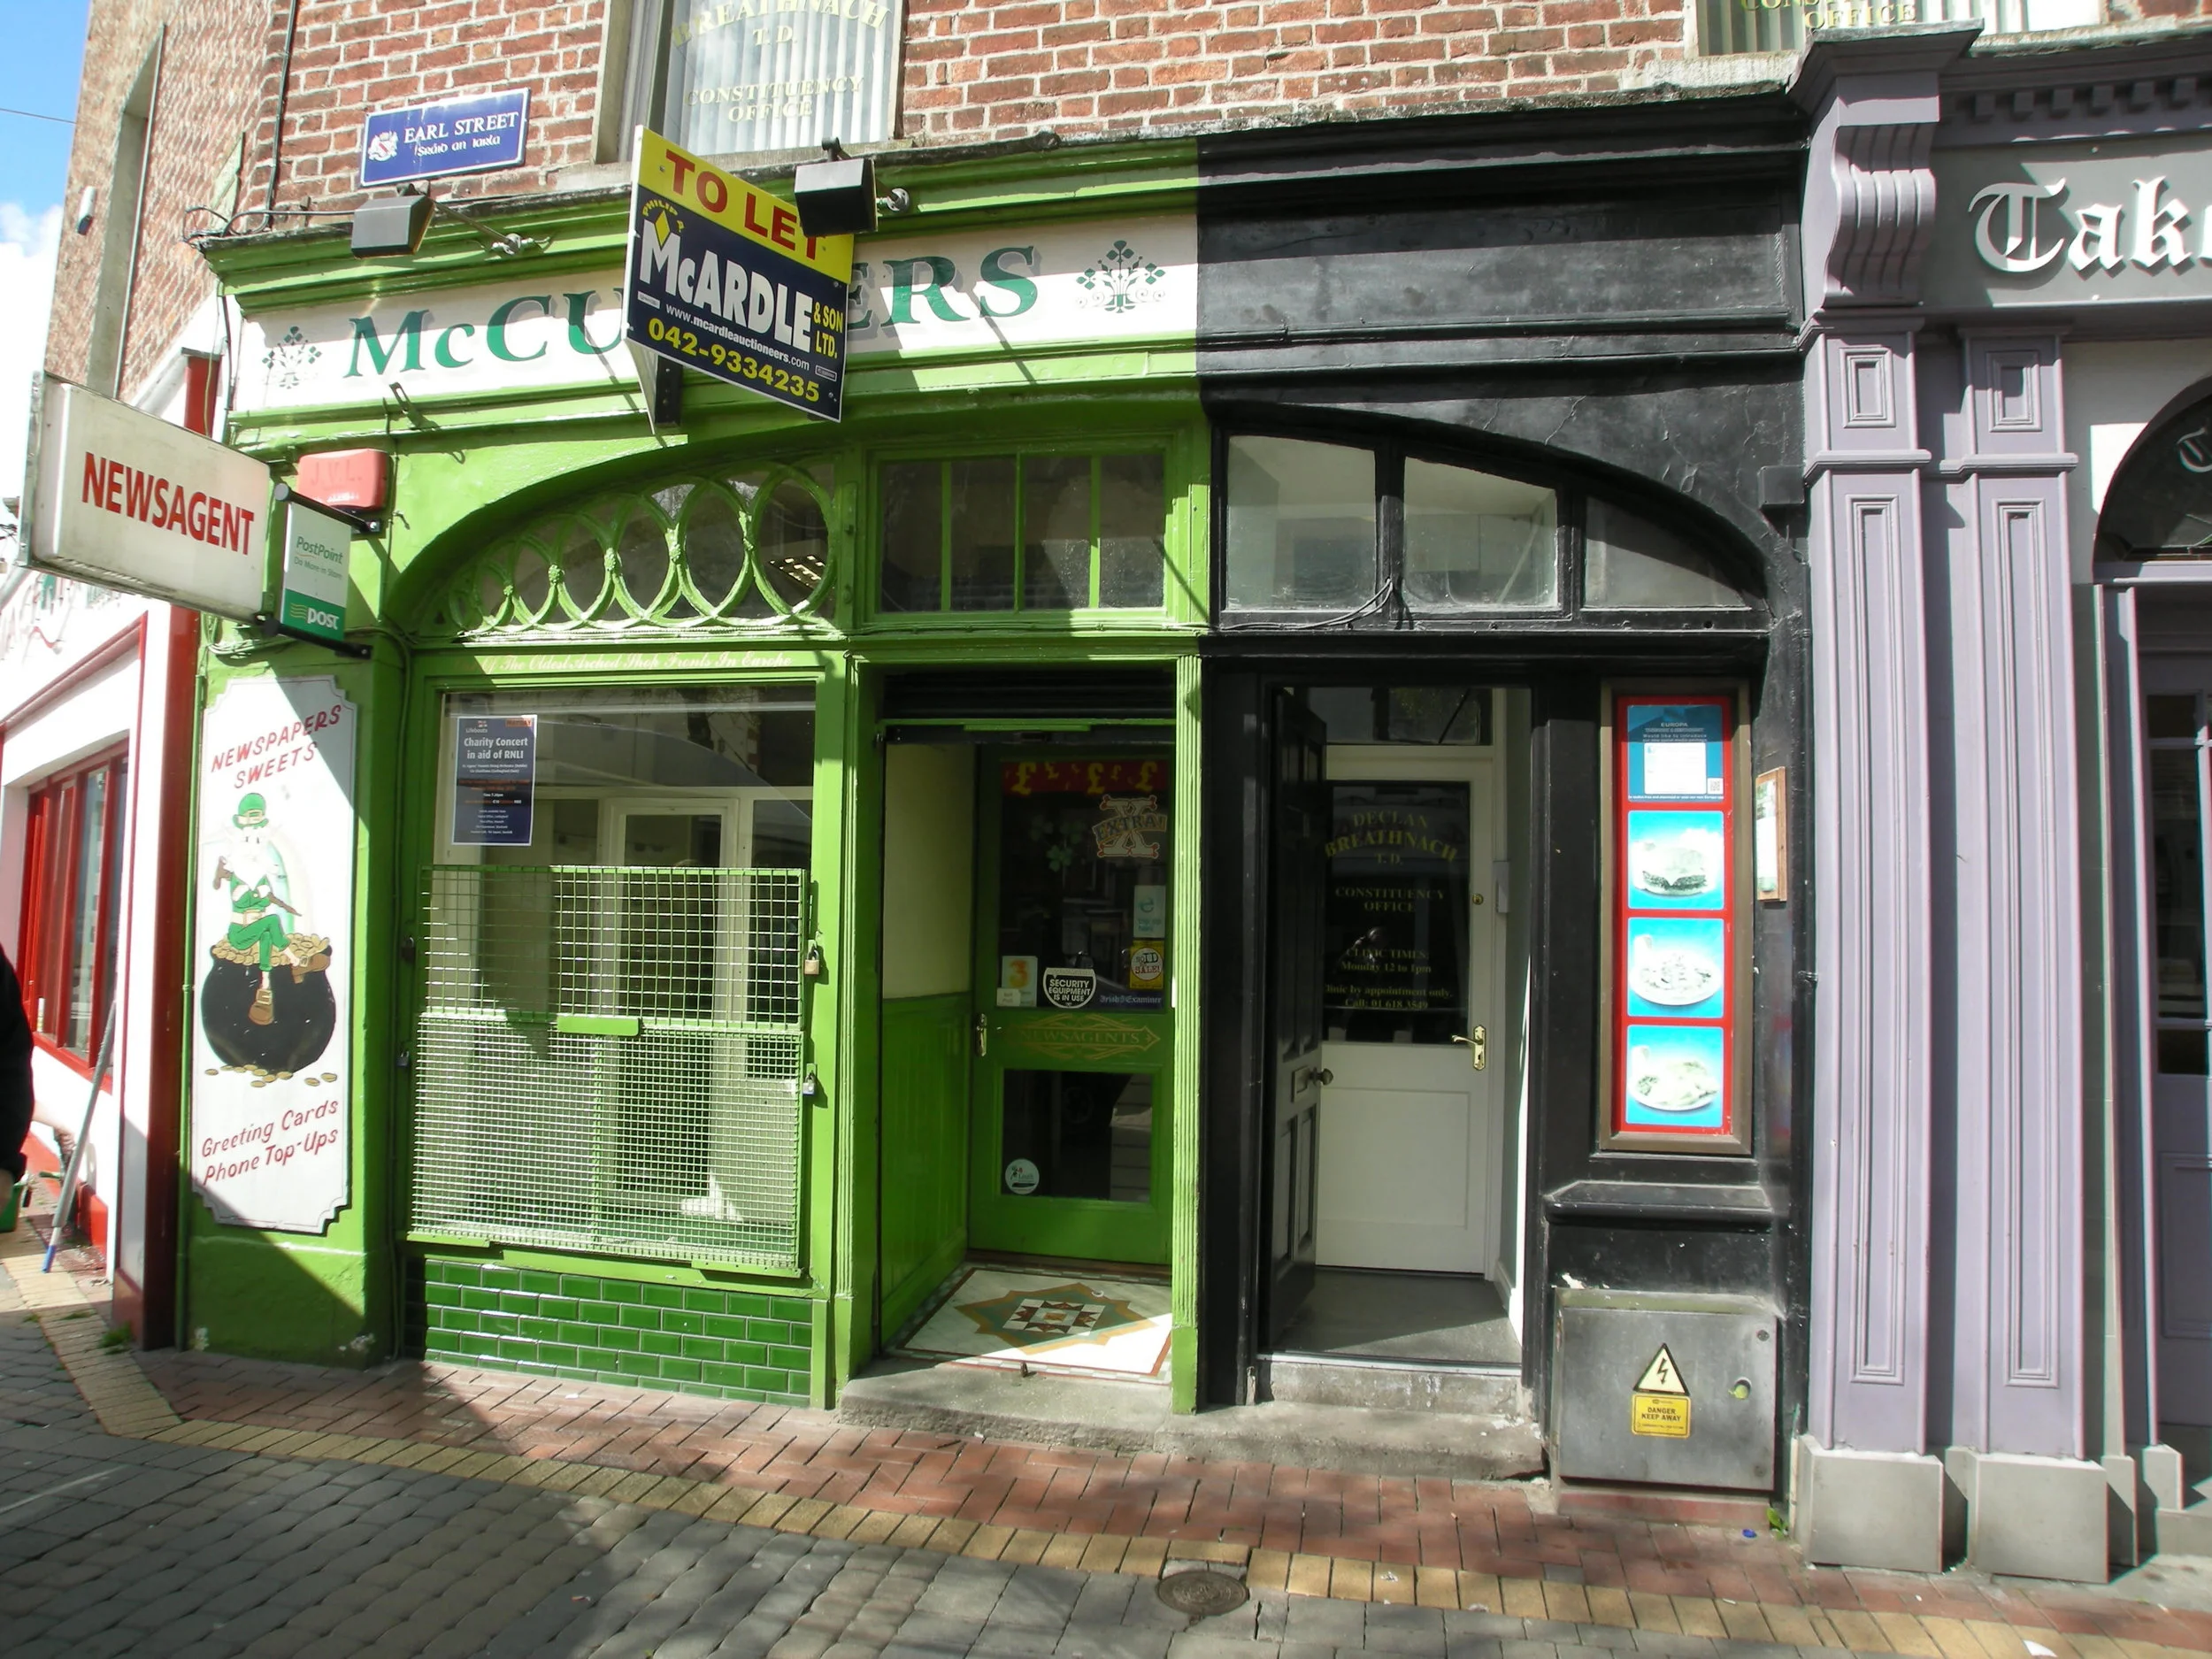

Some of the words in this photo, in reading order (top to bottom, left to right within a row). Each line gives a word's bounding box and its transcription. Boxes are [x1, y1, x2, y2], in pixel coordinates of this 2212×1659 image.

[1804, 4, 1916, 29] OFFICE
[685, 76, 864, 106] CONSTITUENCY
[728, 100, 812, 122] OFFICE
[403, 124, 449, 143] EARL
[455, 111, 519, 136] STREET
[451, 141, 466, 151] an
[665, 149, 727, 213] TO
[642, 199, 679, 217] PHILIP
[1968, 175, 2212, 272] Tak
[639, 218, 814, 353] McARDLE
[813, 302, 821, 325] &
[823, 305, 844, 334] SON
[665, 303, 810, 372] www.mcardleauctioneers.com
[816, 330, 838, 359] LTD.
[648, 317, 820, 403] 042-9334235
[81, 451, 255, 556] NEWSAGENT
[296, 535, 343, 565] PostPoint
[307, 607, 340, 630] post
[500, 655, 524, 671] The
[528, 654, 571, 670] Oldest
[569, 653, 619, 670] Arched
[624, 652, 660, 670] Shop
[664, 651, 711, 669] Fronts
[715, 650, 738, 667] In
[741, 650, 793, 669] Europe
[211, 704, 342, 773] NEWSPAPERS
[464, 737, 494, 749] Charity
[495, 737, 528, 747] Concert
[234, 741, 318, 789] SWEETS
[467, 750, 475, 759] in
[478, 750, 491, 759] aid
[493, 750, 503, 759] of
[504, 750, 524, 759] RNLI
[1353, 810, 1428, 827] DECLAN
[1324, 830, 1458, 862] BREATHNACH
[1335, 886, 1444, 900] CONSTITUENCY
[1363, 902, 1416, 912] OFFICE
[1346, 948, 1386, 958] CLINIC
[1340, 961, 1379, 974] Monday
[1385, 962, 1395, 972] 12
[1397, 963, 1408, 972] to
[1048, 987, 1091, 995] EQUIPMENT
[1049, 979, 1089, 988] SECURITY
[1350, 984, 1363, 996] by
[1364, 986, 1427, 999] appointment
[1099, 995, 1120, 1003] Irish
[1125, 995, 1163, 1004] Examiner
[1020, 1029, 1140, 1044] NEWSAGENTS
[202, 1122, 274, 1157] Greeting
[281, 1100, 339, 1131] Cards
[203, 1156, 260, 1186] Phone
[265, 1129, 338, 1166] Top-Ups
